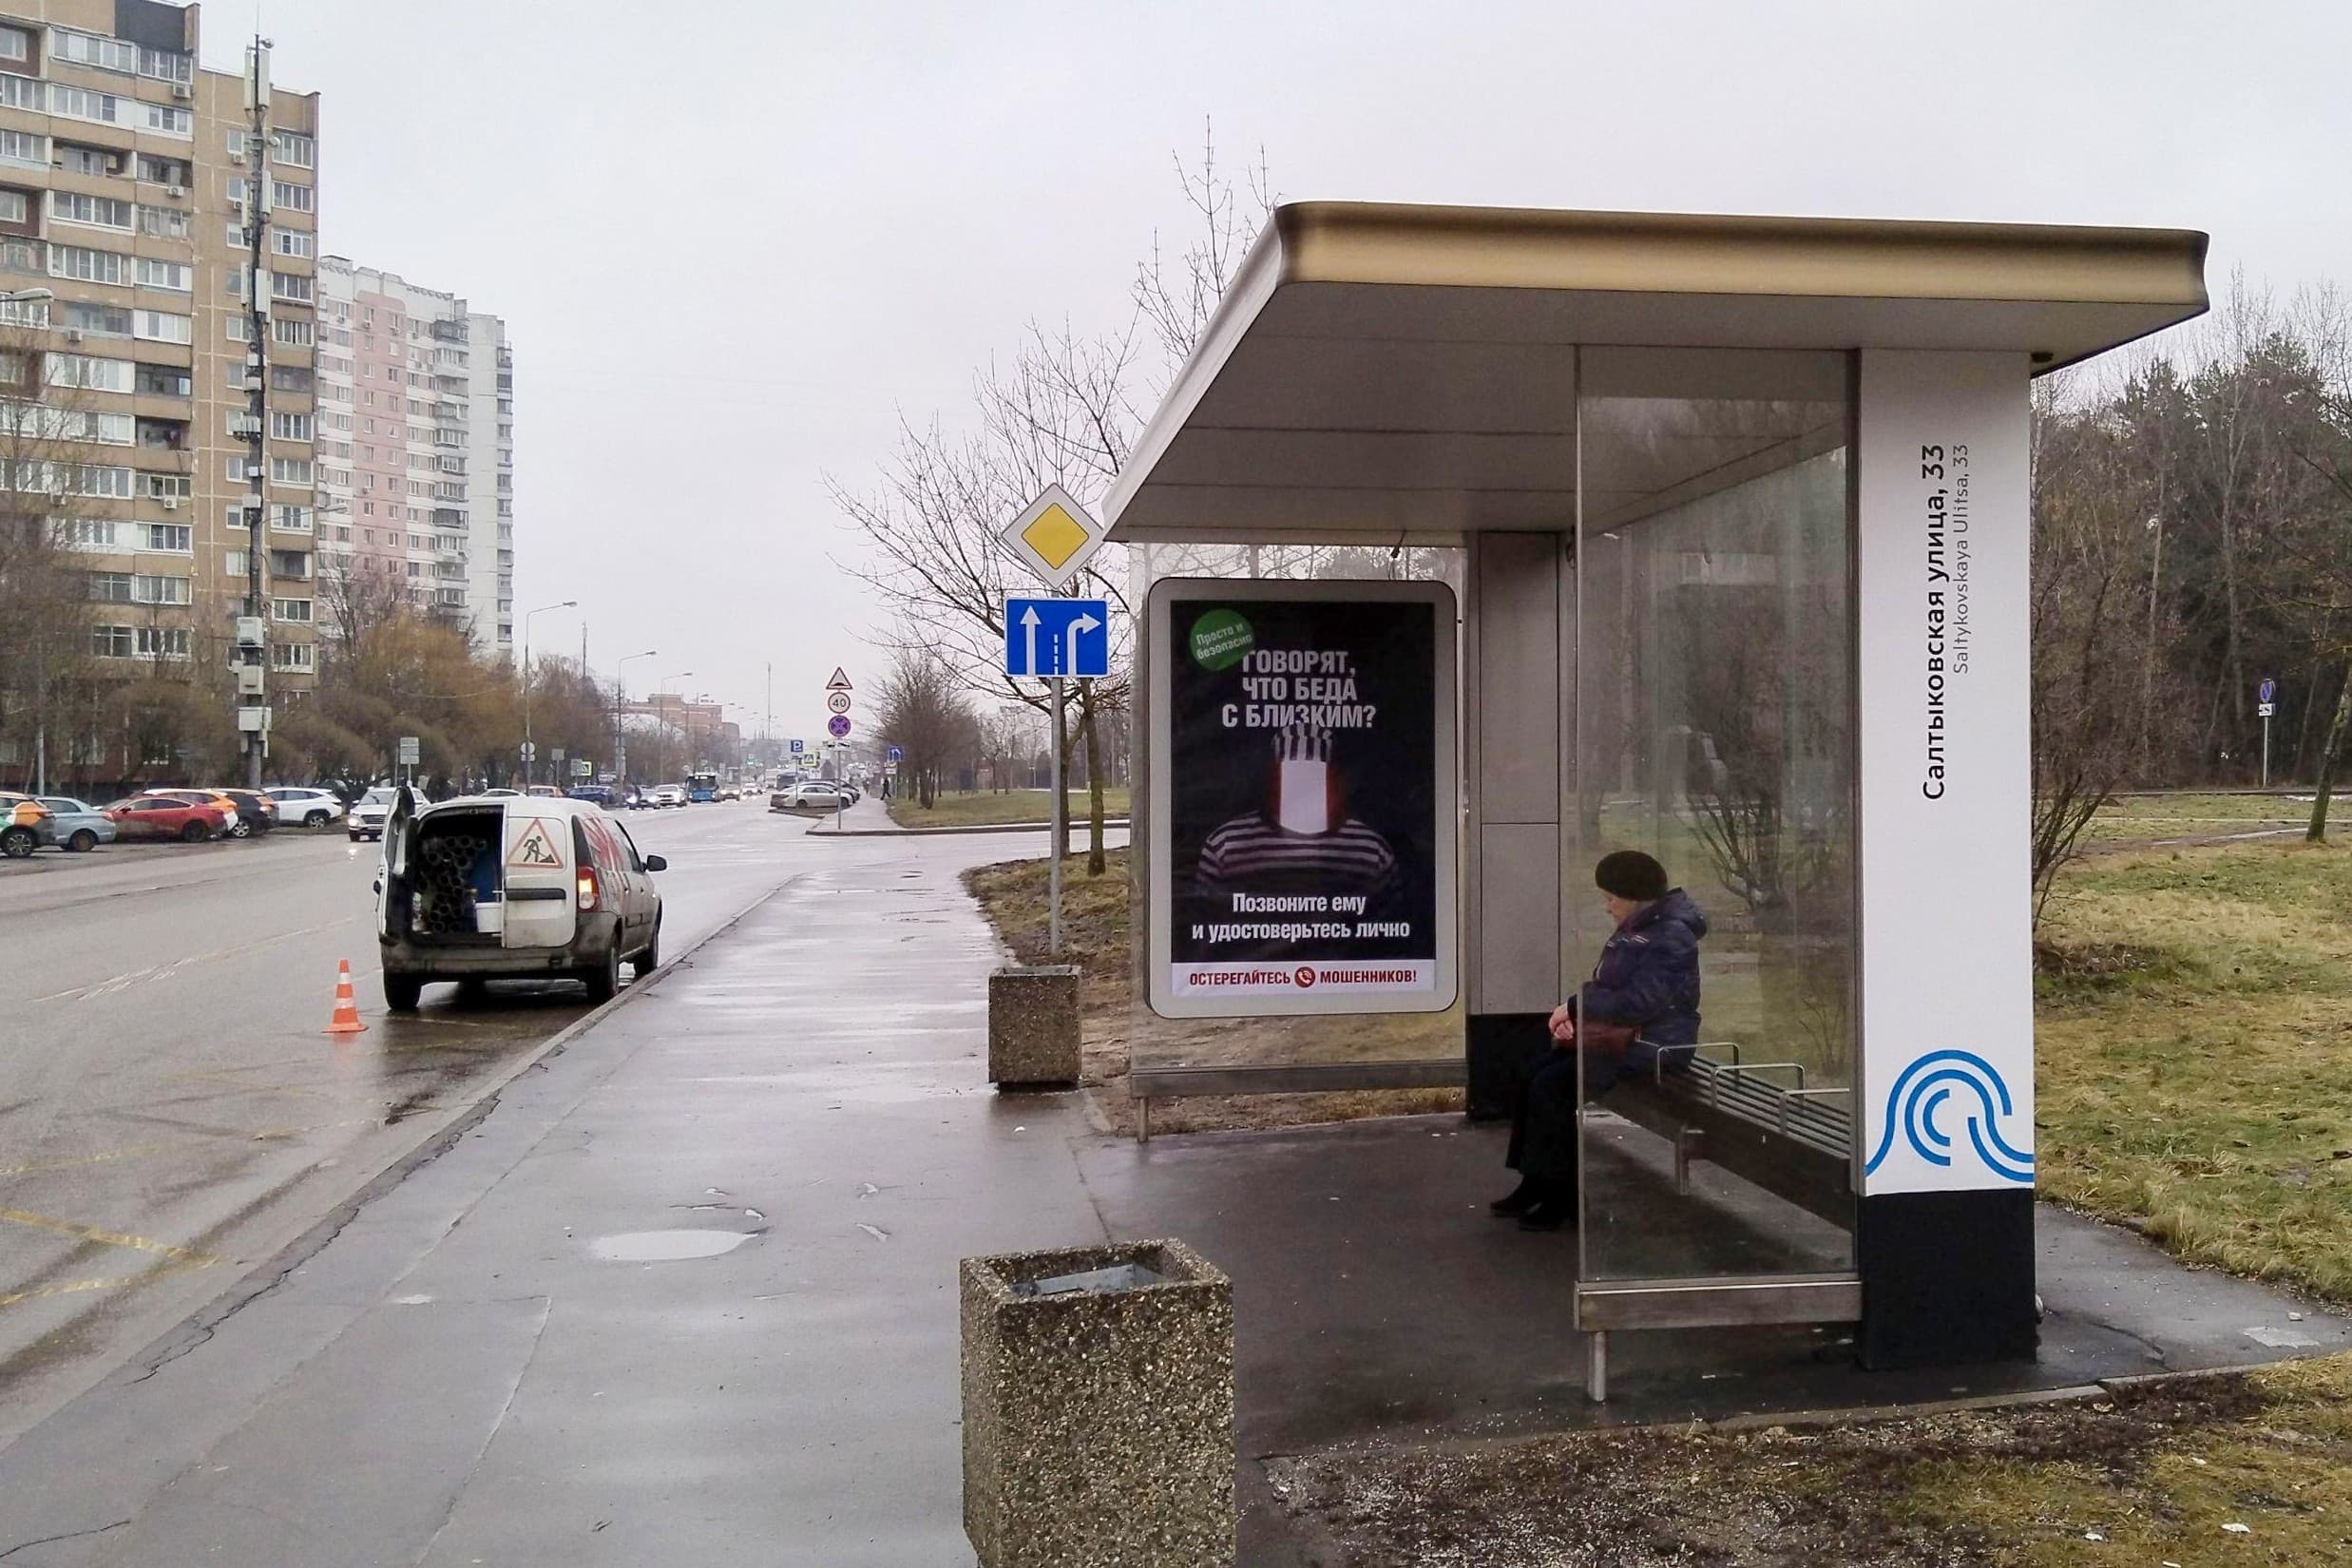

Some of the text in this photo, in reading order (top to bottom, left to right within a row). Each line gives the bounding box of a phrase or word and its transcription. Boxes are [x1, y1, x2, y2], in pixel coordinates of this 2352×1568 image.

[1953, 444, 1972, 674] Saltykovskaya Ulitsa, 33
[1196, 622, 1244, 645] Просто и
[1922, 445, 1949, 800] Салтыковская улица, 33
[1196, 634, 1252, 660] безопасно
[1242, 649, 1356, 677] ГОВОРЯТ,
[832, 698, 846, 707] 40
[1242, 677, 1358, 705] ЧТО БЕДА
[1222, 703, 1376, 729] С БЛИЗКИМ?
[1233, 892, 1367, 915] Позвоните ему
[1192, 922, 1410, 944] и удостоверьтесь лично
[1190, 969, 1416, 986] ОСТЕРЕГАЙТЕСЬ МОШЕННИКОВ!
